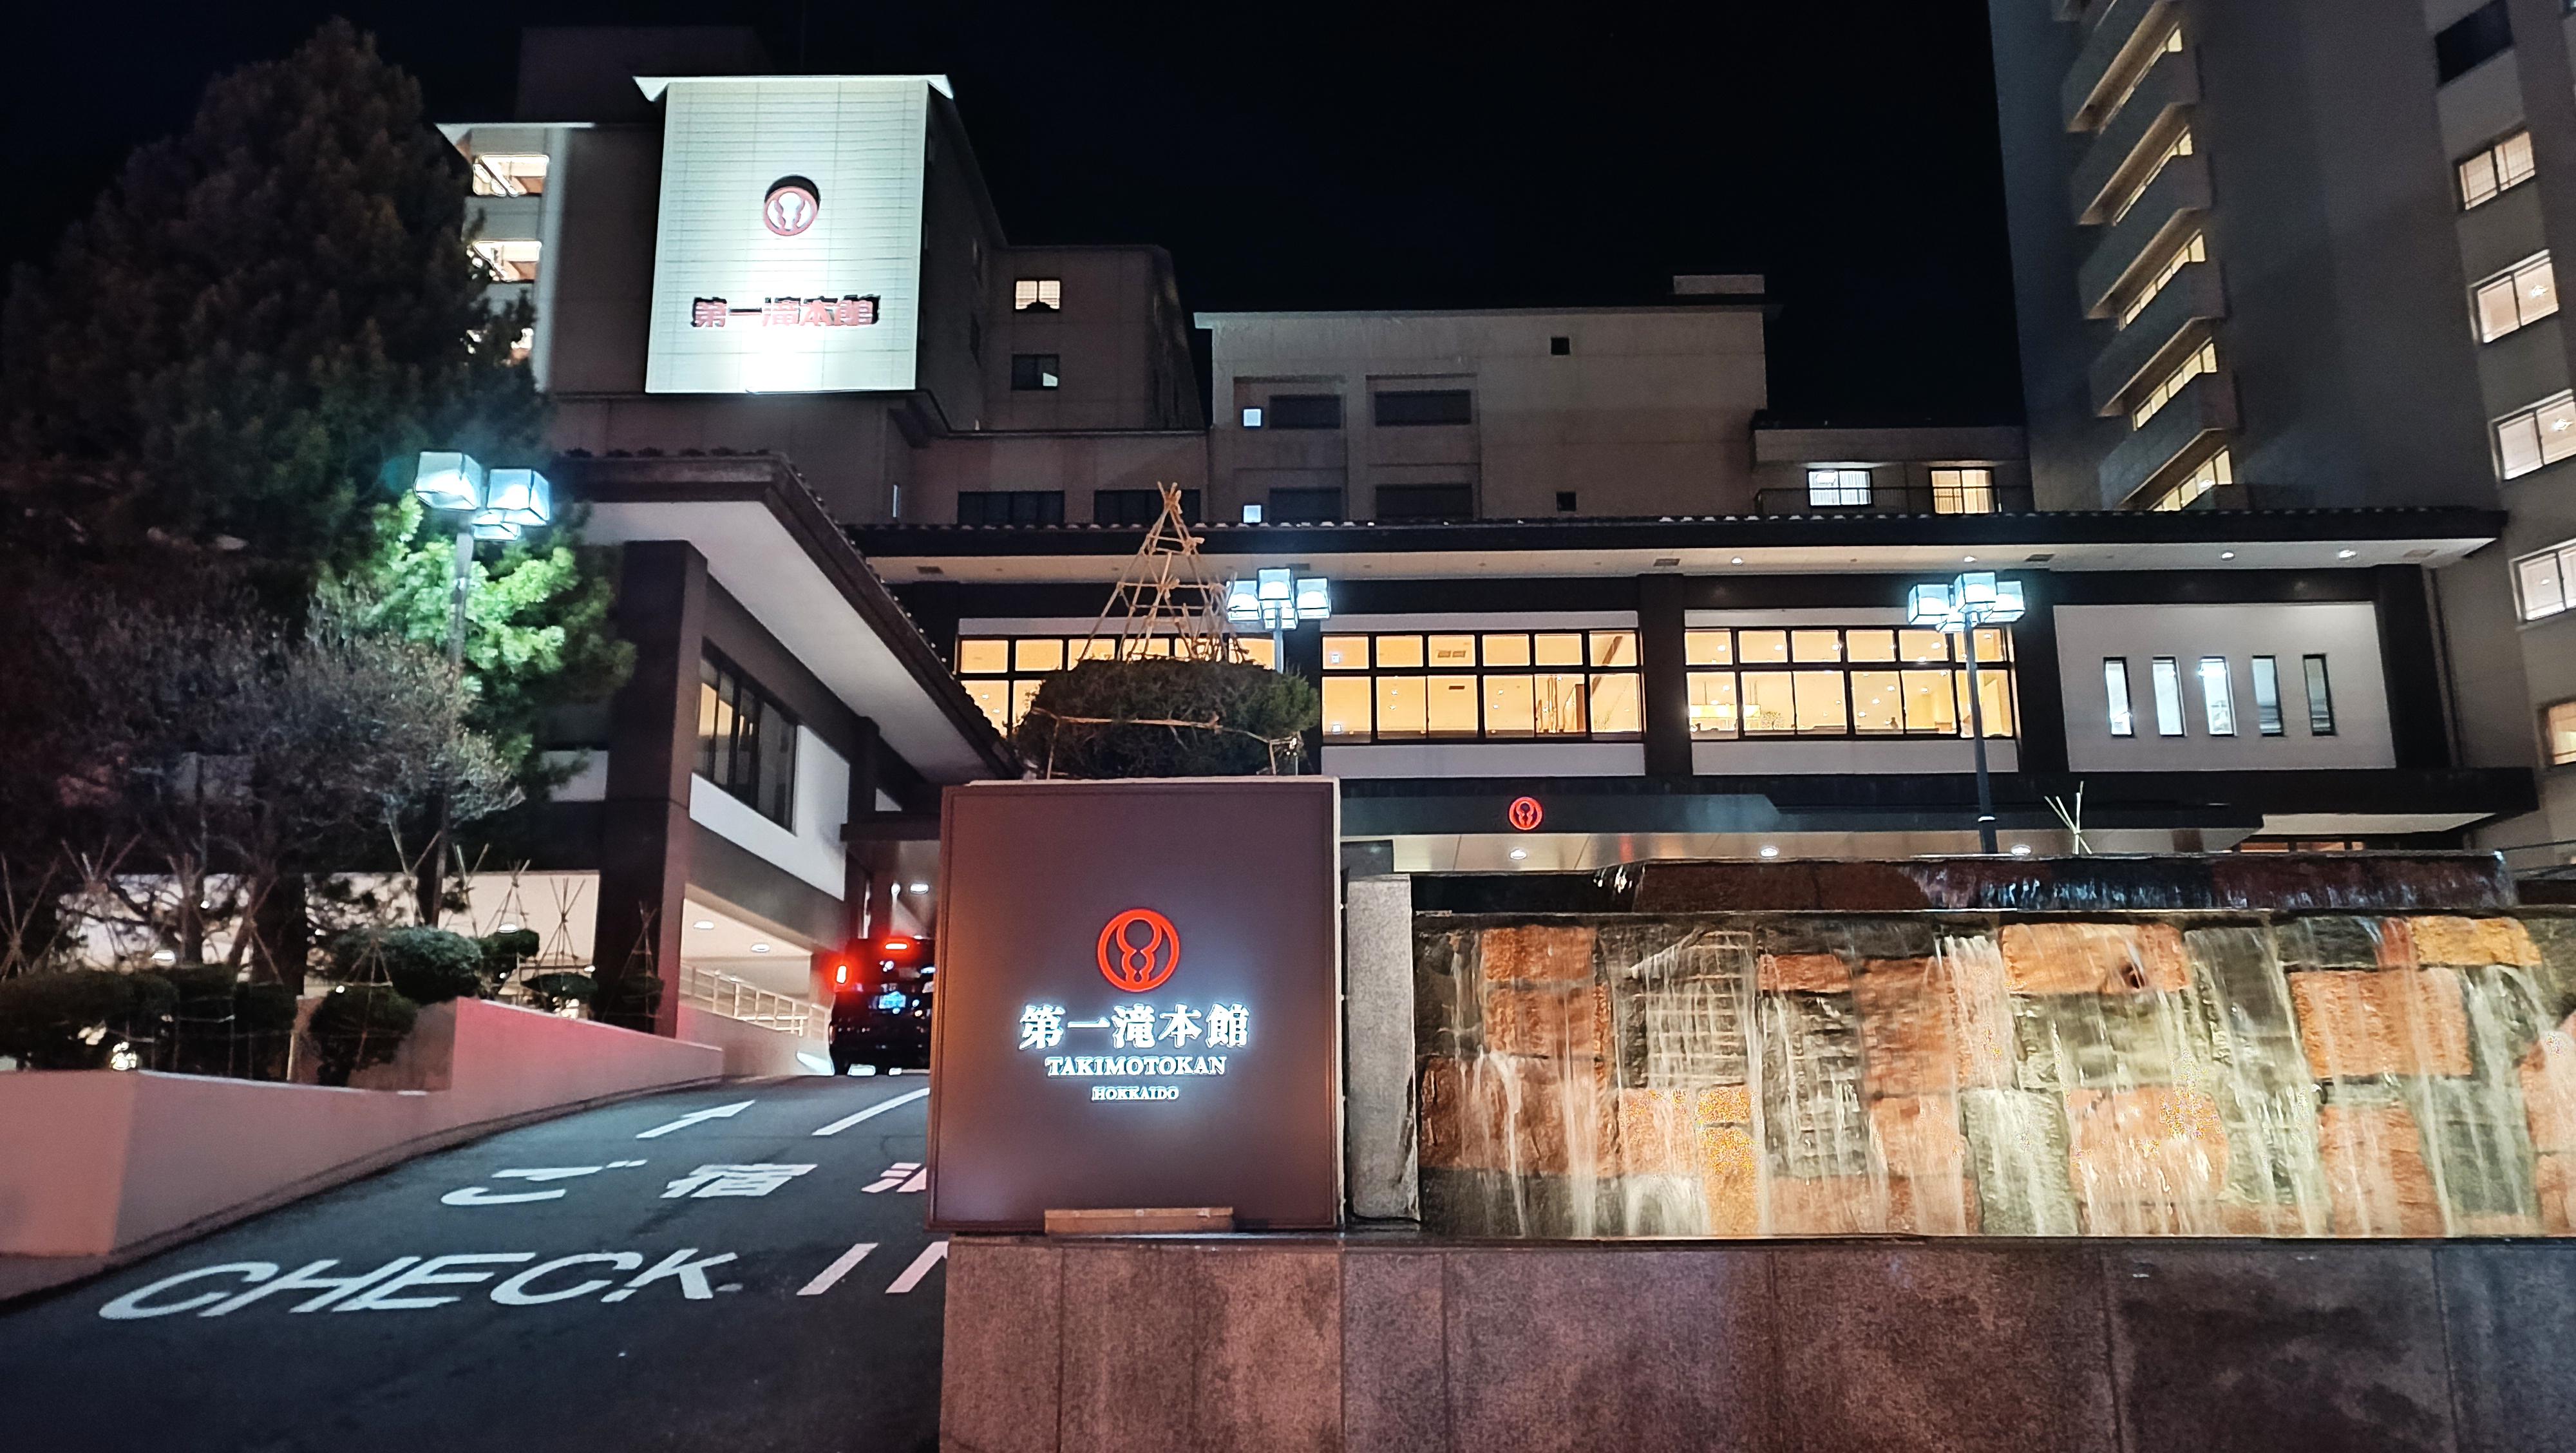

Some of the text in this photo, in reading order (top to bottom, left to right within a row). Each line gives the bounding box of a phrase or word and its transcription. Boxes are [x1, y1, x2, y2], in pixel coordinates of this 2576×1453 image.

[1019, 1003, 1249, 1050] 第一滝本館
[1045, 1056, 1227, 1076] TAKIMOTOKAN
[1092, 1086, 1179, 1101] HOKKAIDO
[99, 1248, 743, 1320] CHECK
